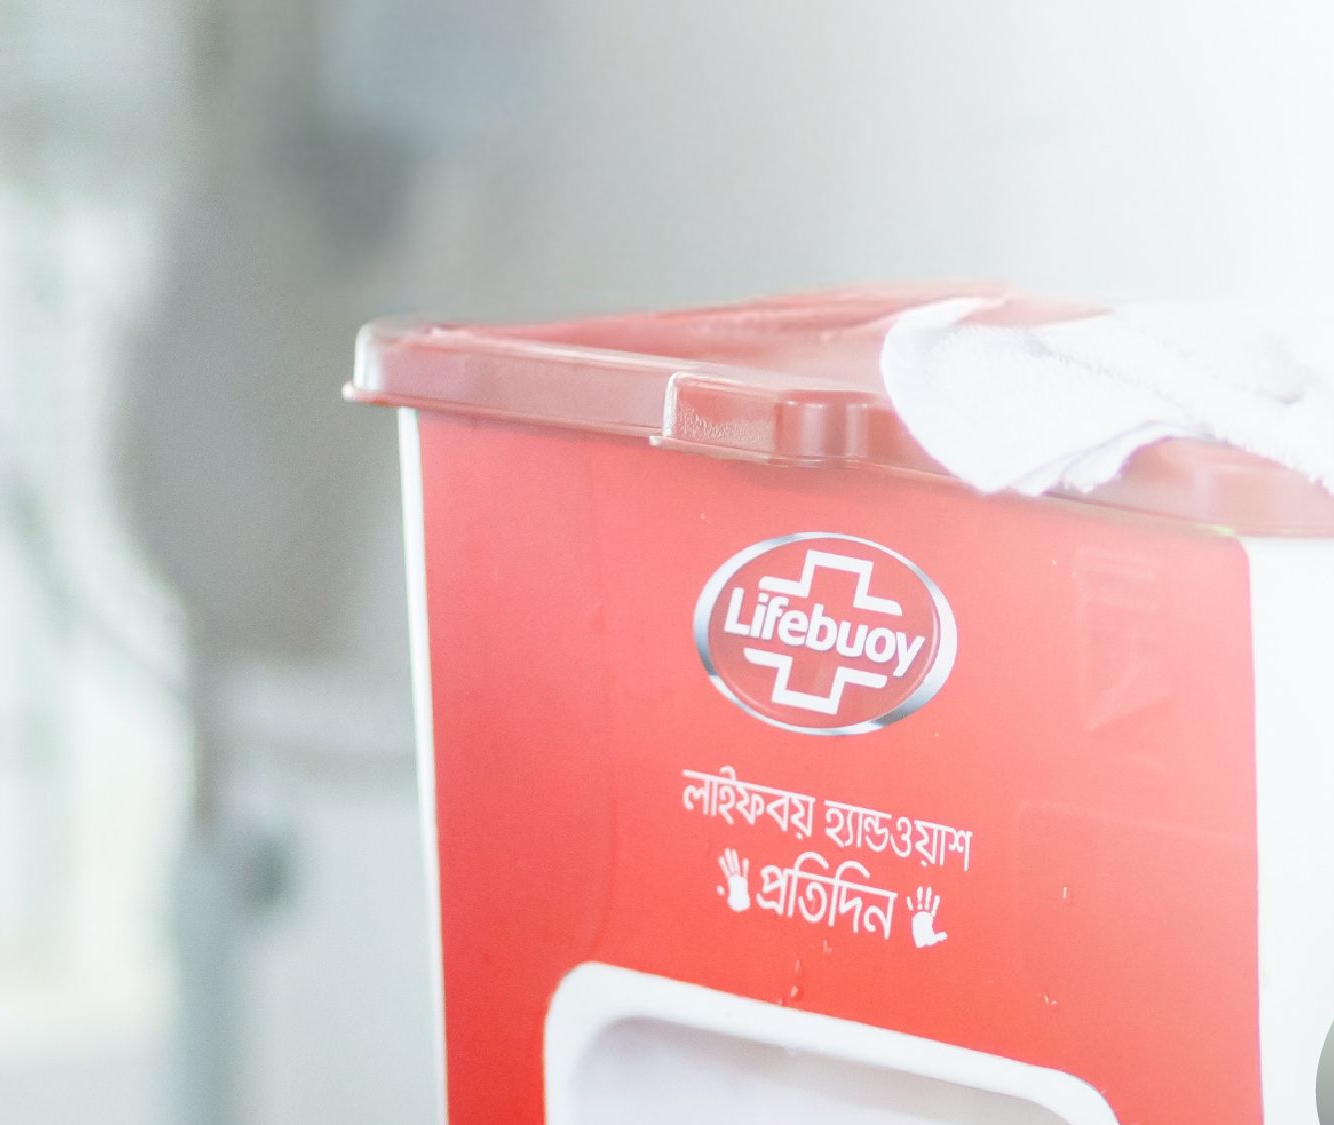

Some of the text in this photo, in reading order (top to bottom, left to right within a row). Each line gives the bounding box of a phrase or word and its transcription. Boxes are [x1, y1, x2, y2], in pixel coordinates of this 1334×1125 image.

[724, 587, 926, 676] Lifebuoy
[681, 766, 973, 871] লাইফবয় হ্যান্ডওয়াশ
[757, 852, 898, 939] প্রতিদিন
